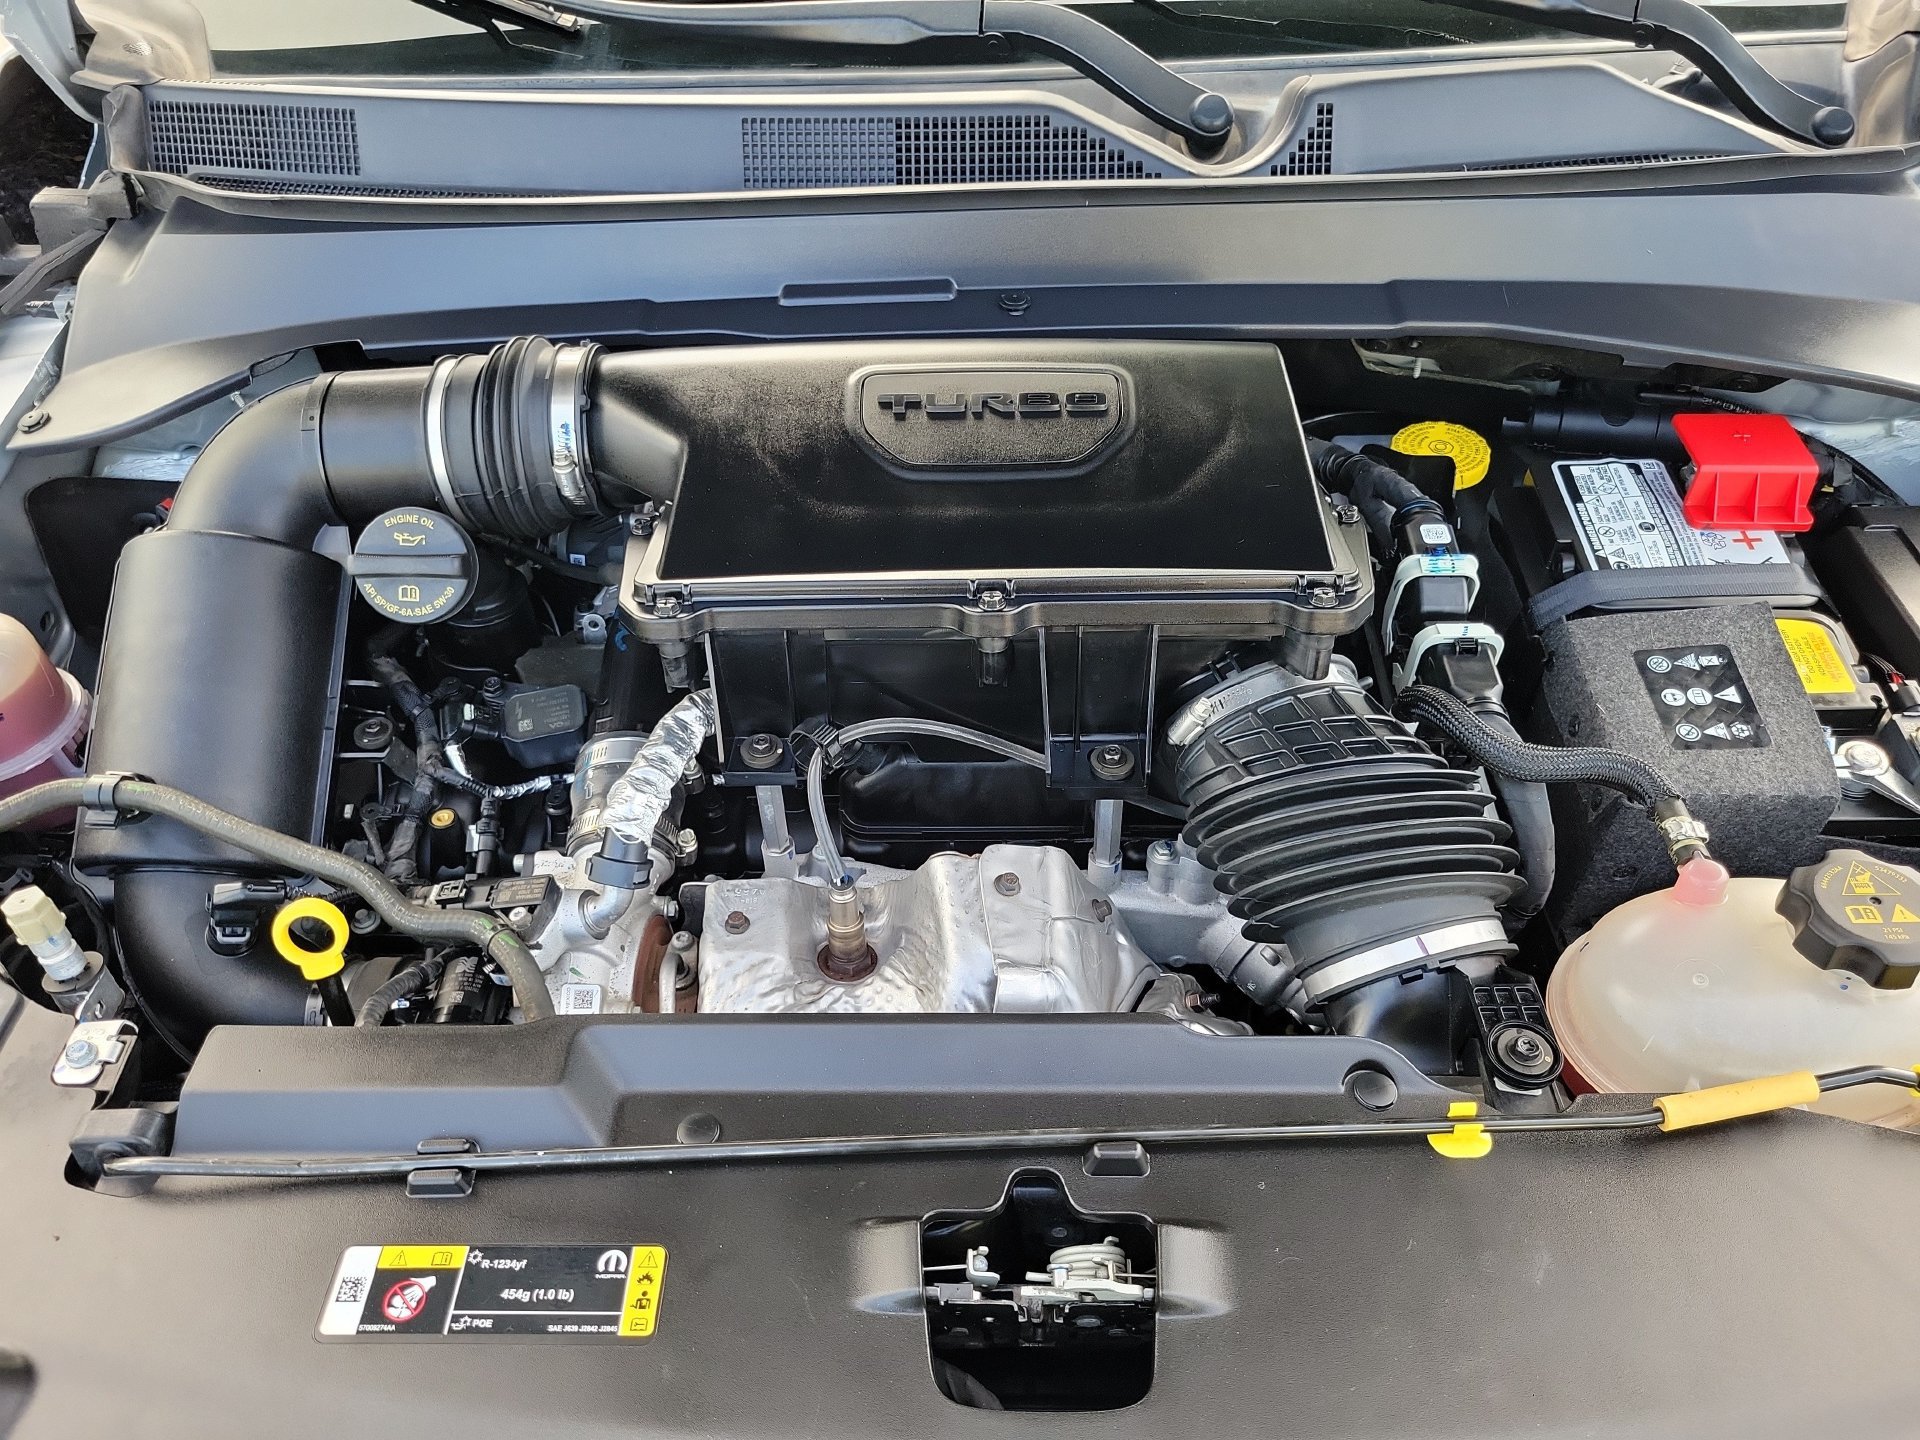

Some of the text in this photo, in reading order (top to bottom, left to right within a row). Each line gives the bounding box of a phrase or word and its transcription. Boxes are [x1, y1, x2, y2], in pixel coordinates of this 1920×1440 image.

[877, 392, 1109, 417] TURBO
[385, 514, 434, 529] ENGINE OIL
[1576, 503, 1602, 549] DANGER/POISON
[434, 586, 455, 609] 5W-30
[481, 1258, 527, 1272] R-1234yf
[500, 1286, 575, 1303] 454g (1.0 lb)
[472, 1318, 494, 1329] POE
[547, 1324, 564, 1332] SAE
[562, 1324, 580, 1332] J639
[578, 1324, 598, 1332] J2842
